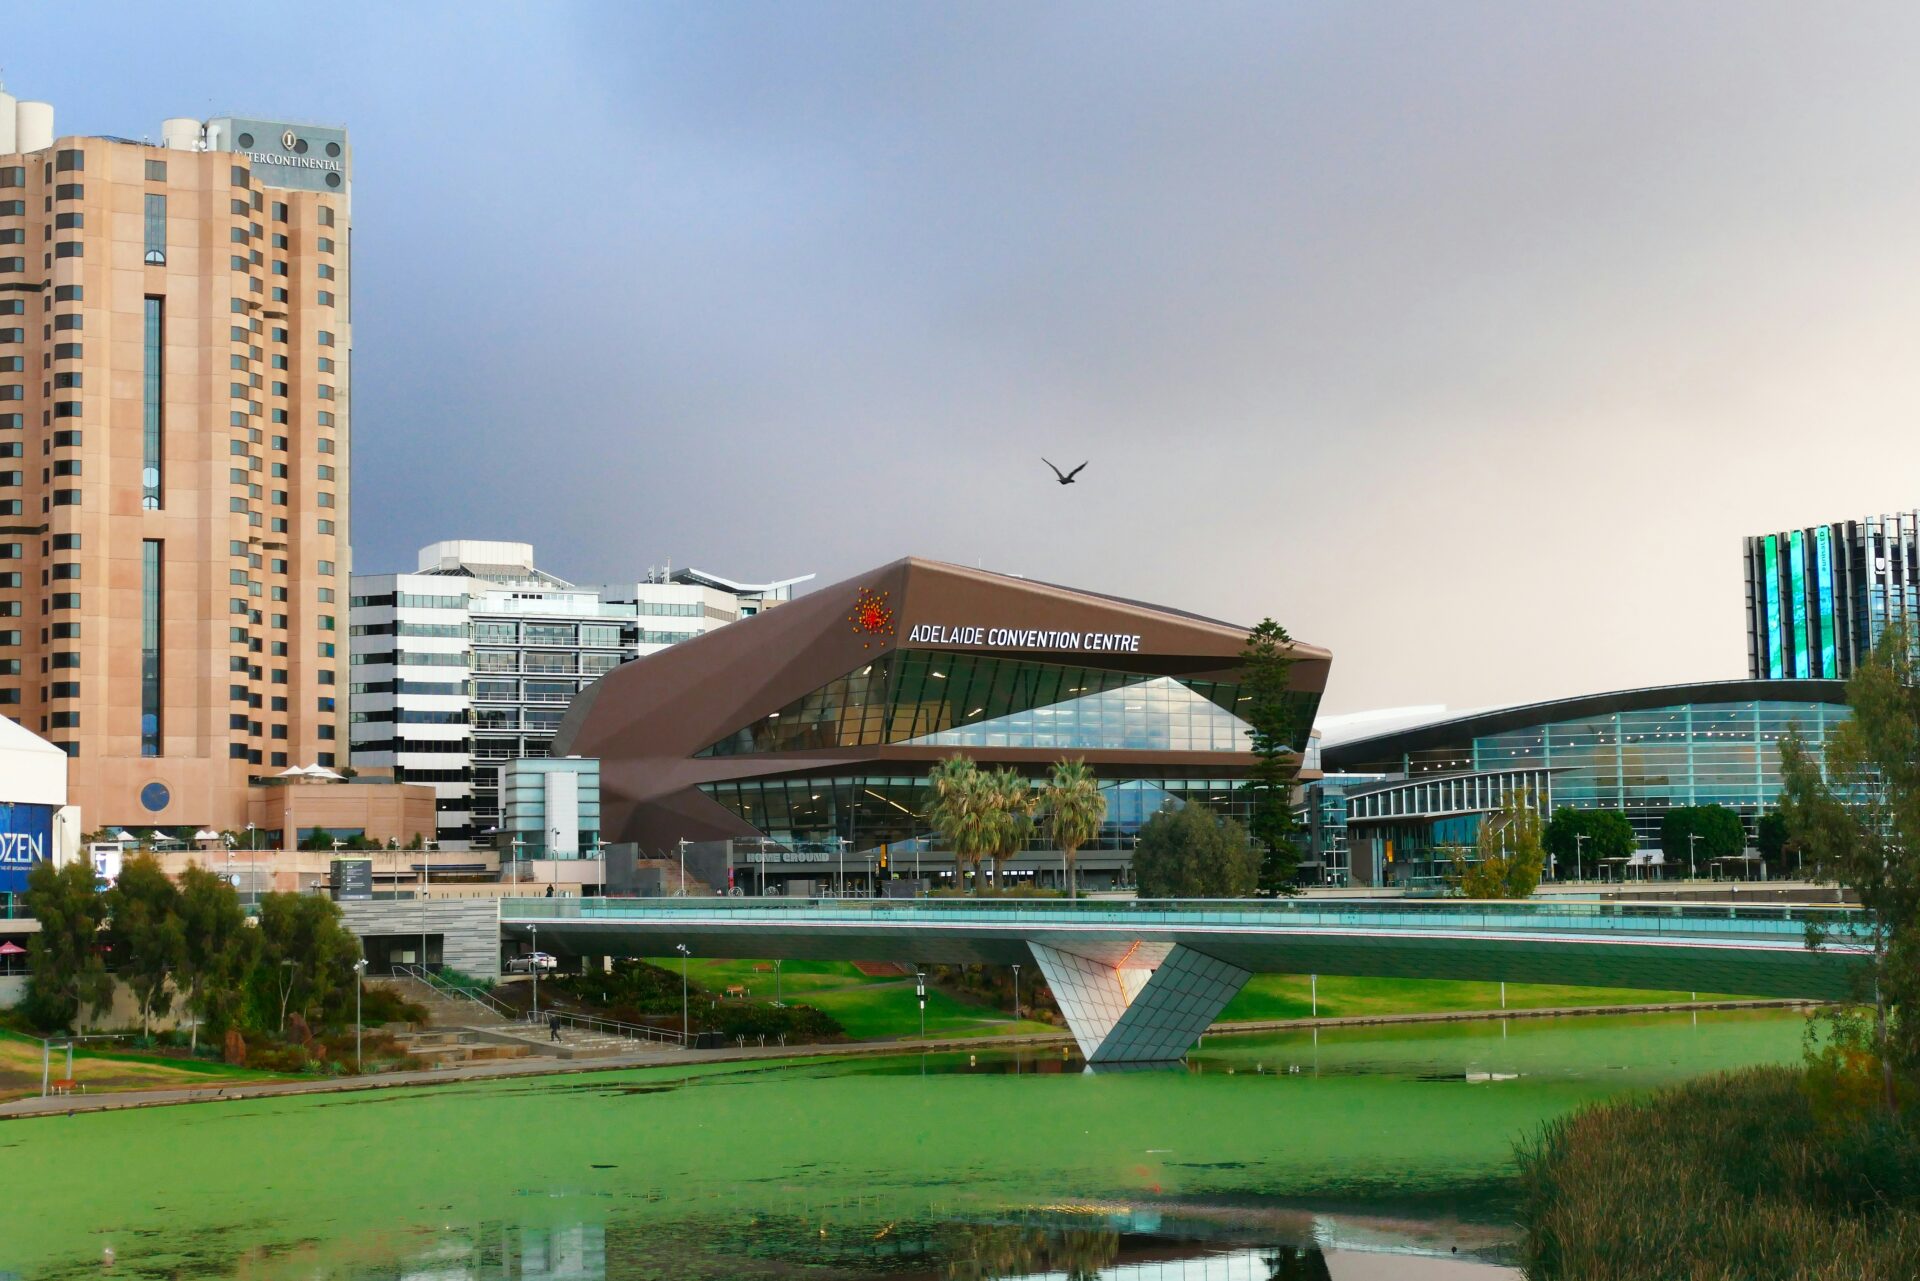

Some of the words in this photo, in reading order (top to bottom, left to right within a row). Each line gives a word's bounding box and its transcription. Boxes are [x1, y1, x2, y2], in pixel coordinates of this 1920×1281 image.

[235, 149, 342, 171] TERCONTINENTAL
[909, 625, 984, 645] ADELAIDE
[987, 629, 1081, 649] CONVENTION
[1084, 633, 1141, 651] CENTRE
[782, 852, 830, 862] GROUND
